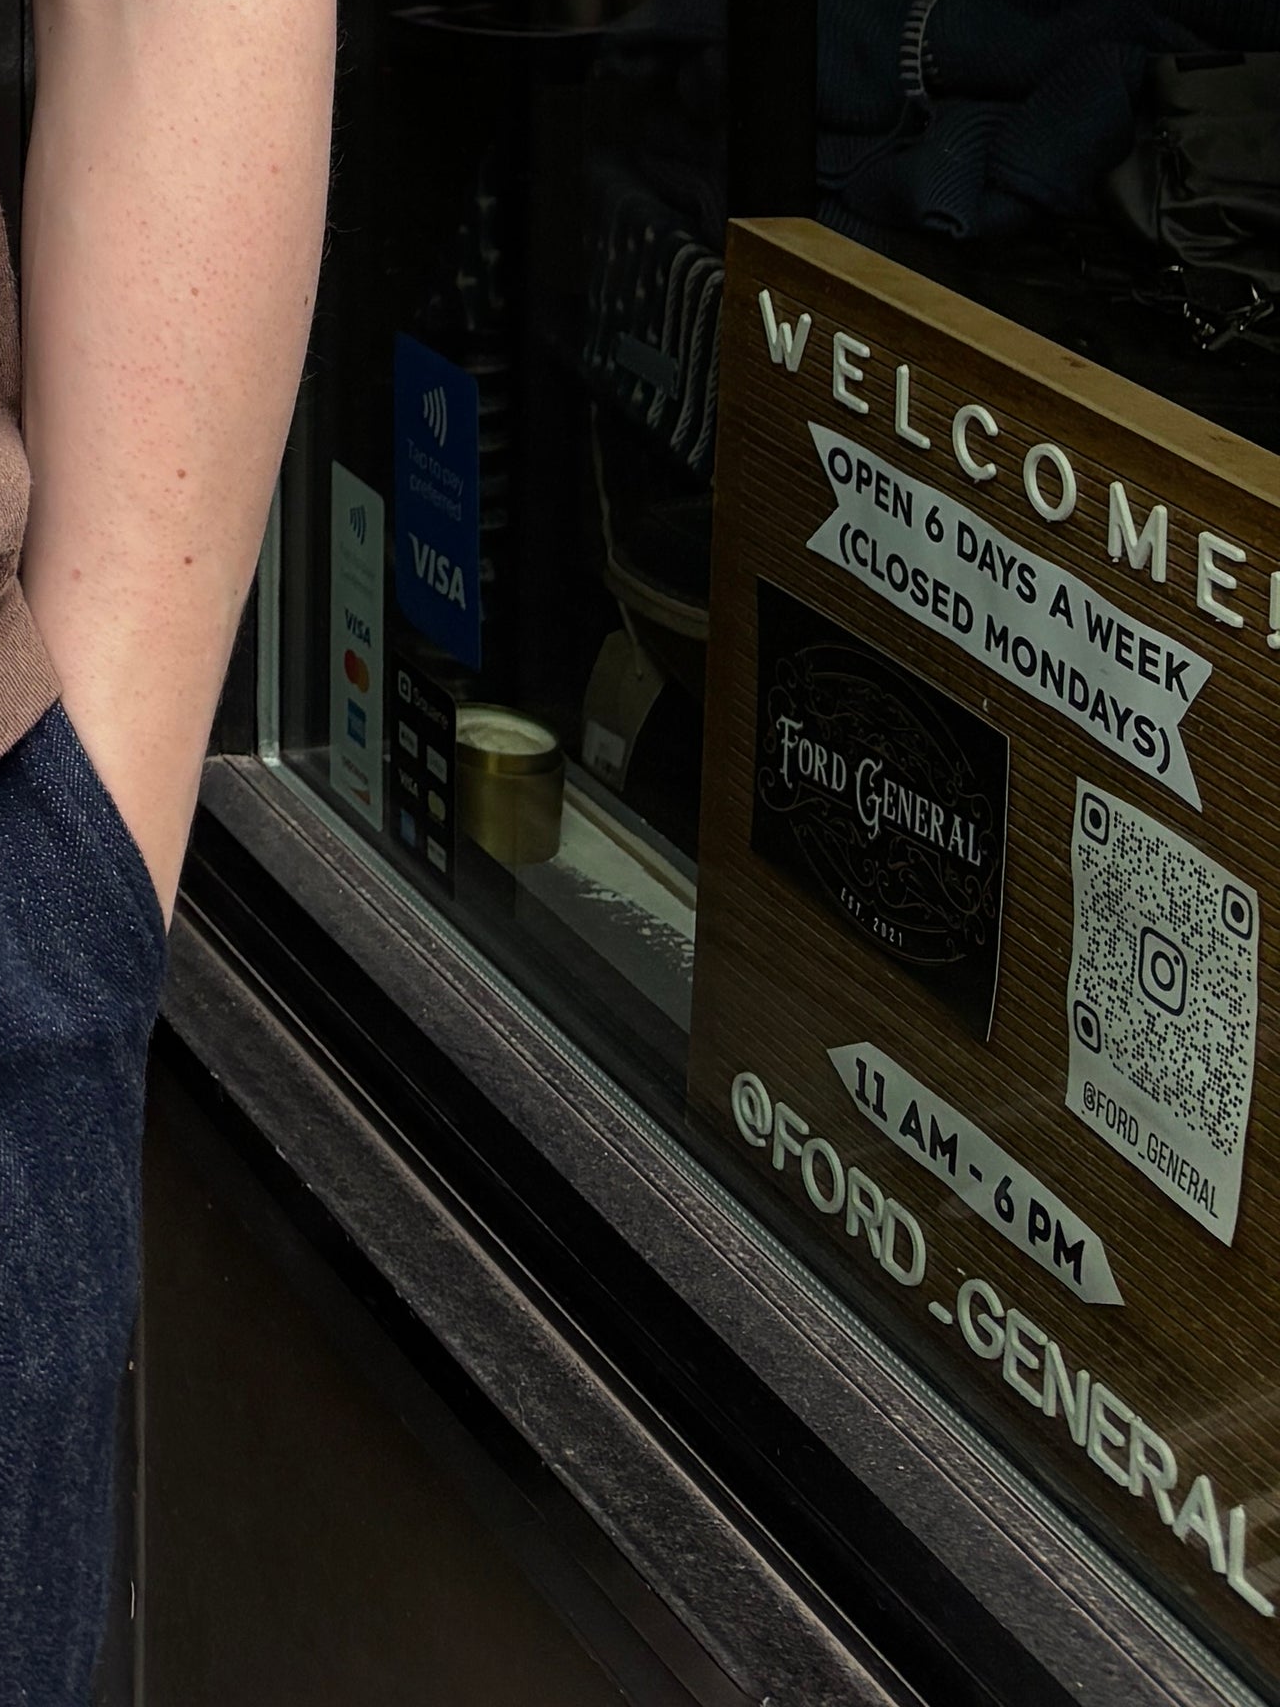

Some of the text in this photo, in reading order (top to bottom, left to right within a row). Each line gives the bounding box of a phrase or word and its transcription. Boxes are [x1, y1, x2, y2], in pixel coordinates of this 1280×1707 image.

[344, 608, 372, 648] VISA
[407, 531, 467, 612] VISA
[827, 447, 1190, 703] OPEN 6 DAYS A WEEK
[839, 522, 1172, 774] (CLOSED MONDAYS)
[776, 714, 986, 867] FORD GENERAL
[872, 911, 905, 949] 2021
[854, 1057, 889, 1123] 11
[898, 1100, 959, 1177] AM
[992, 1175, 1015, 1224] 6
[1028, 1200, 1086, 1286] PM
[1082, 1081, 1219, 1220] @FORD_GENERAL
